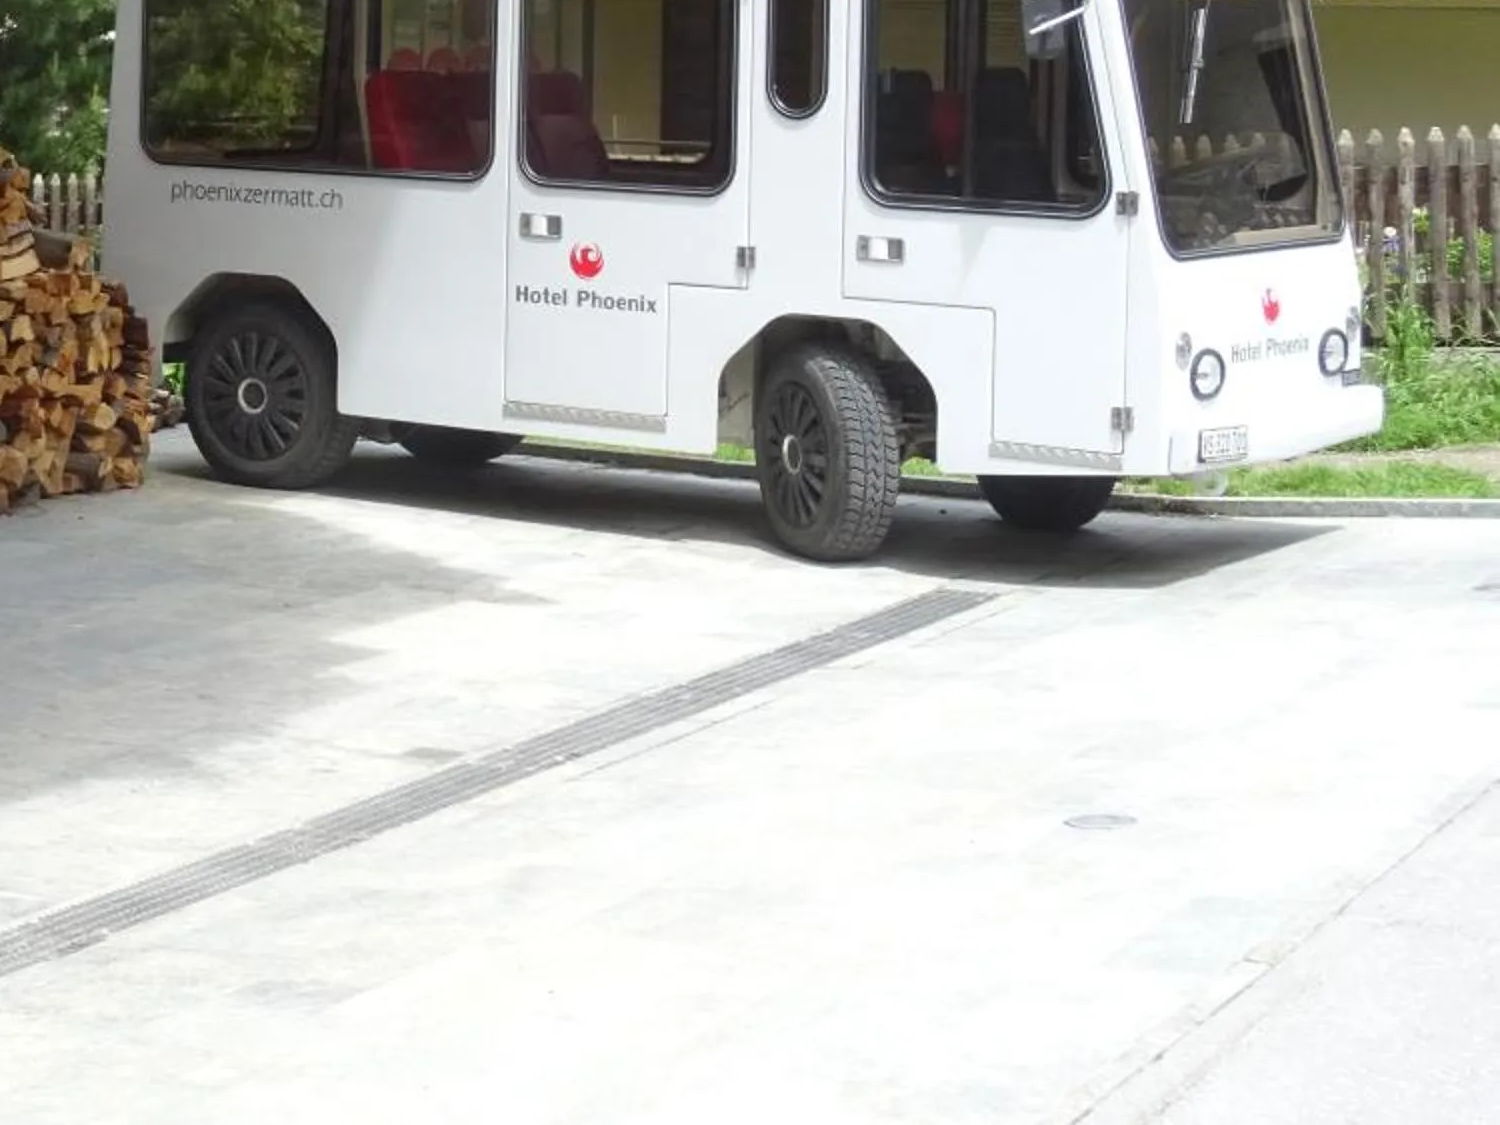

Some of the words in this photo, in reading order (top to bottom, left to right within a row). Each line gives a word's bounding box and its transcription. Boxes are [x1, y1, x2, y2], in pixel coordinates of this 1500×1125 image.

[171, 180, 344, 210] phoenixzermatt.ch
[515, 285, 567, 306] Hotel
[577, 289, 657, 313] Phoenix
[1231, 341, 1261, 363] Hotel
